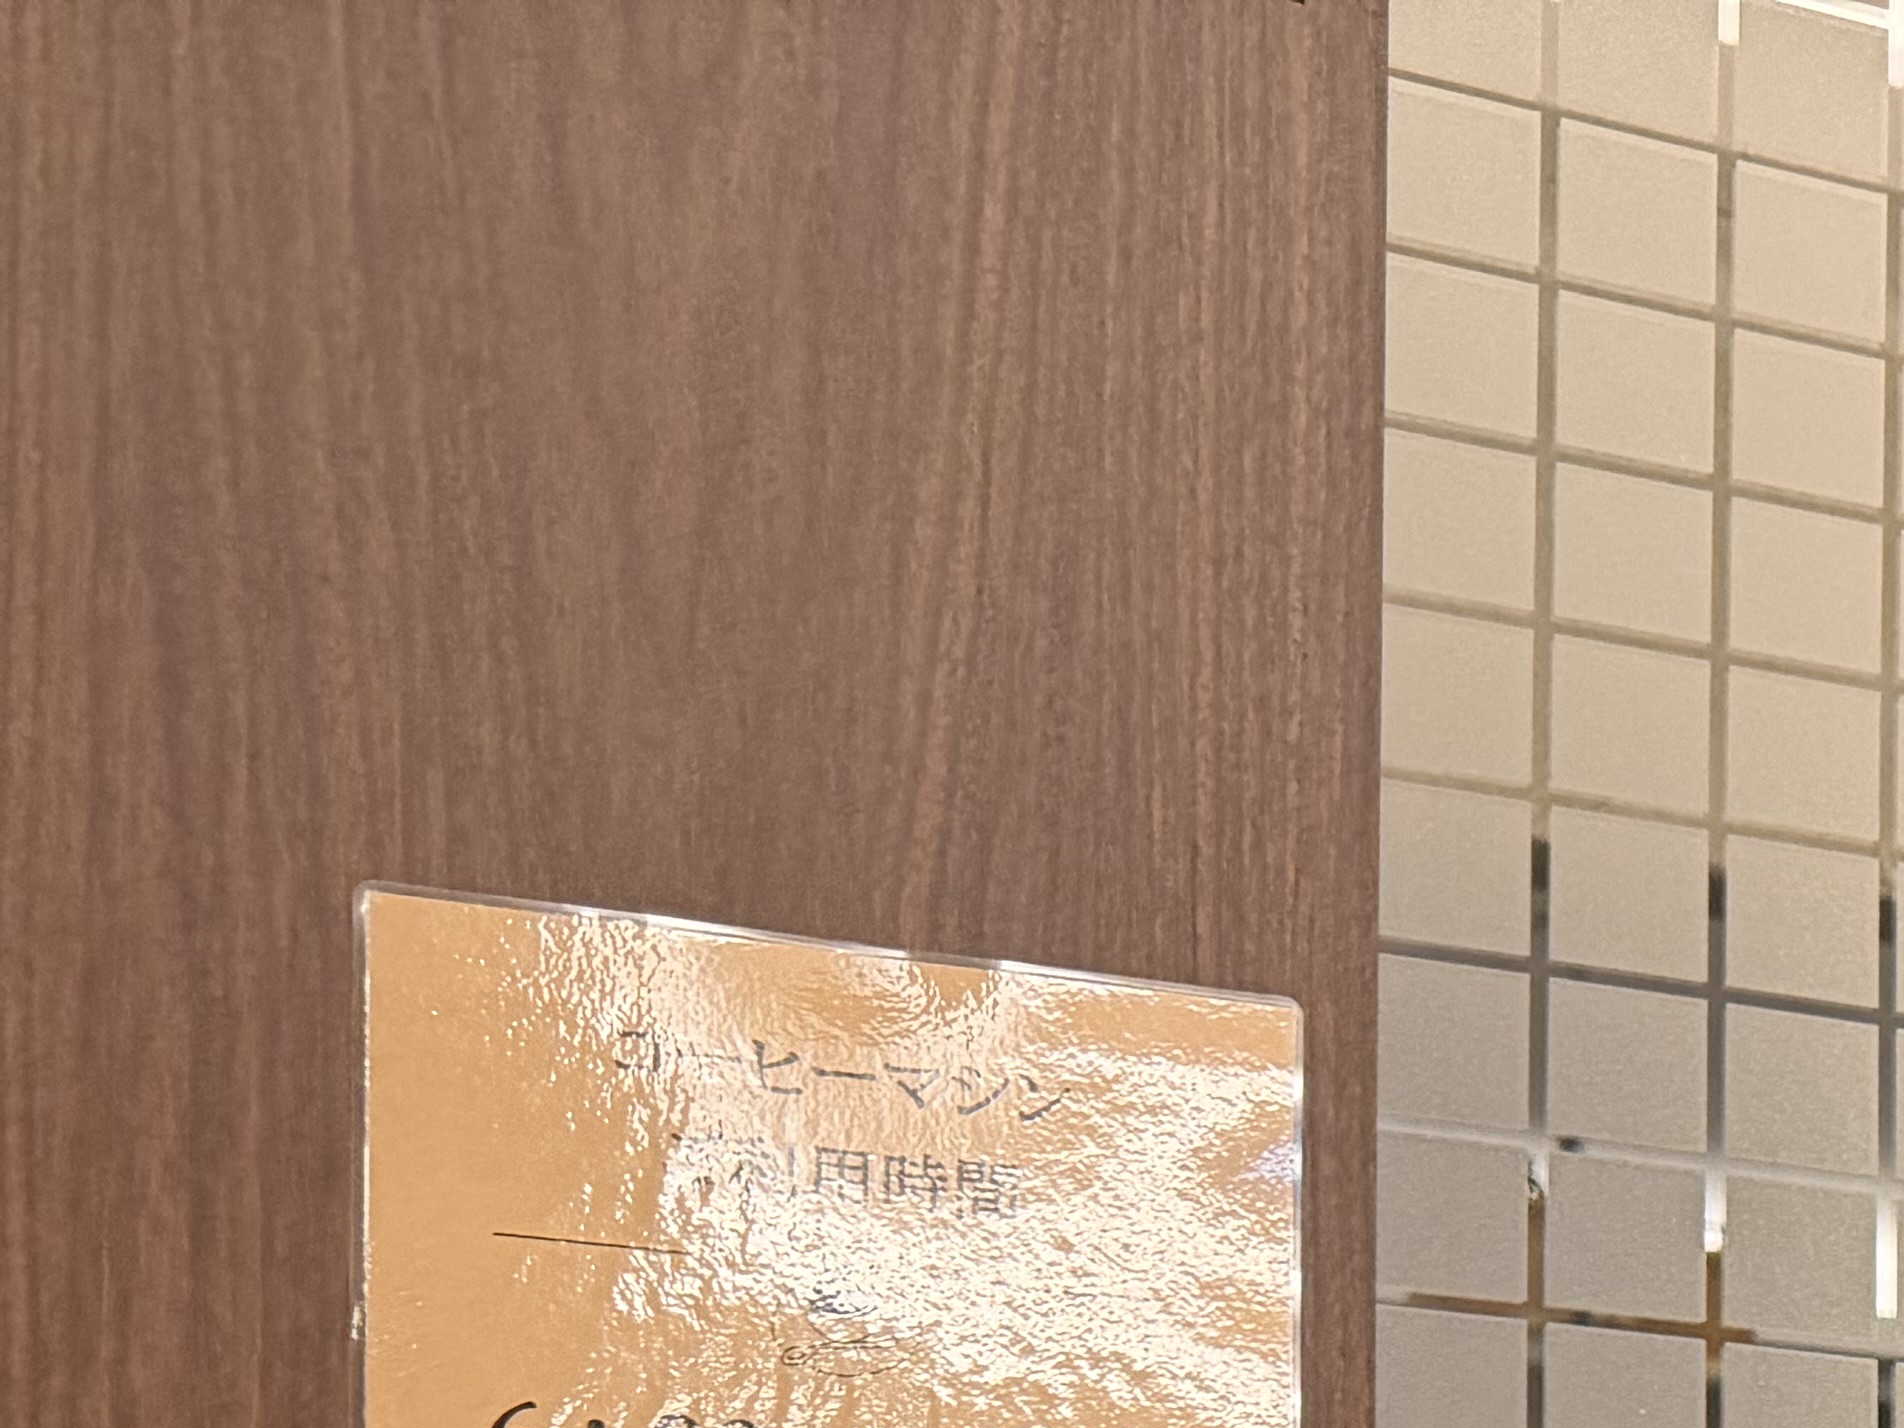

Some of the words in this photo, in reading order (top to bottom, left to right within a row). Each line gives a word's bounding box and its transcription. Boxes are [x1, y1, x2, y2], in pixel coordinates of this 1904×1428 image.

[614, 1028, 1071, 1122] コーヒーマシン
